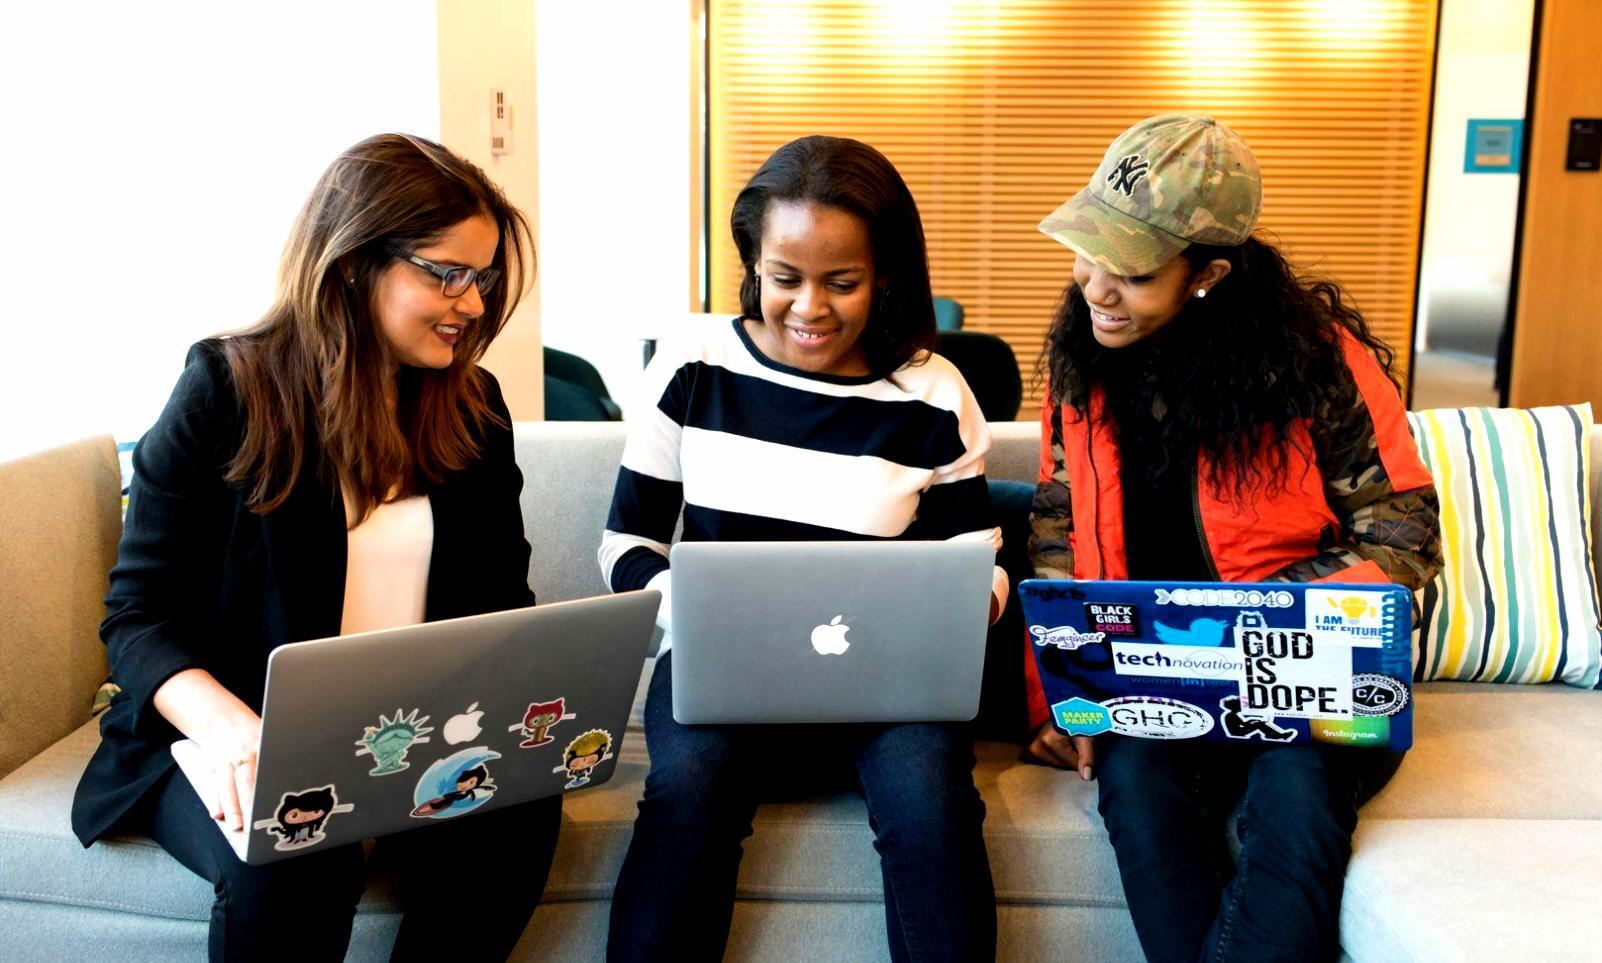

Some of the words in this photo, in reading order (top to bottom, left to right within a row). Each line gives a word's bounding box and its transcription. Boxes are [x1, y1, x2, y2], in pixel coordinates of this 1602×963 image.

[1090, 605, 1132, 615] BLACK
[1095, 614, 1131, 624] GIRLS
[1323, 615, 1343, 625] AM
[1095, 624, 1134, 632] CODE
[1032, 626, 1103, 648] Femgineer
[1241, 630, 1314, 660] GOD
[1115, 650, 1243, 670] technovation
[1244, 657, 1277, 685] IS
[1246, 683, 1349, 714] DOPE.
[1061, 711, 1103, 719] MAKER
[1111, 708, 1193, 728] GHC
[1322, 729, 1378, 741] Instagram
